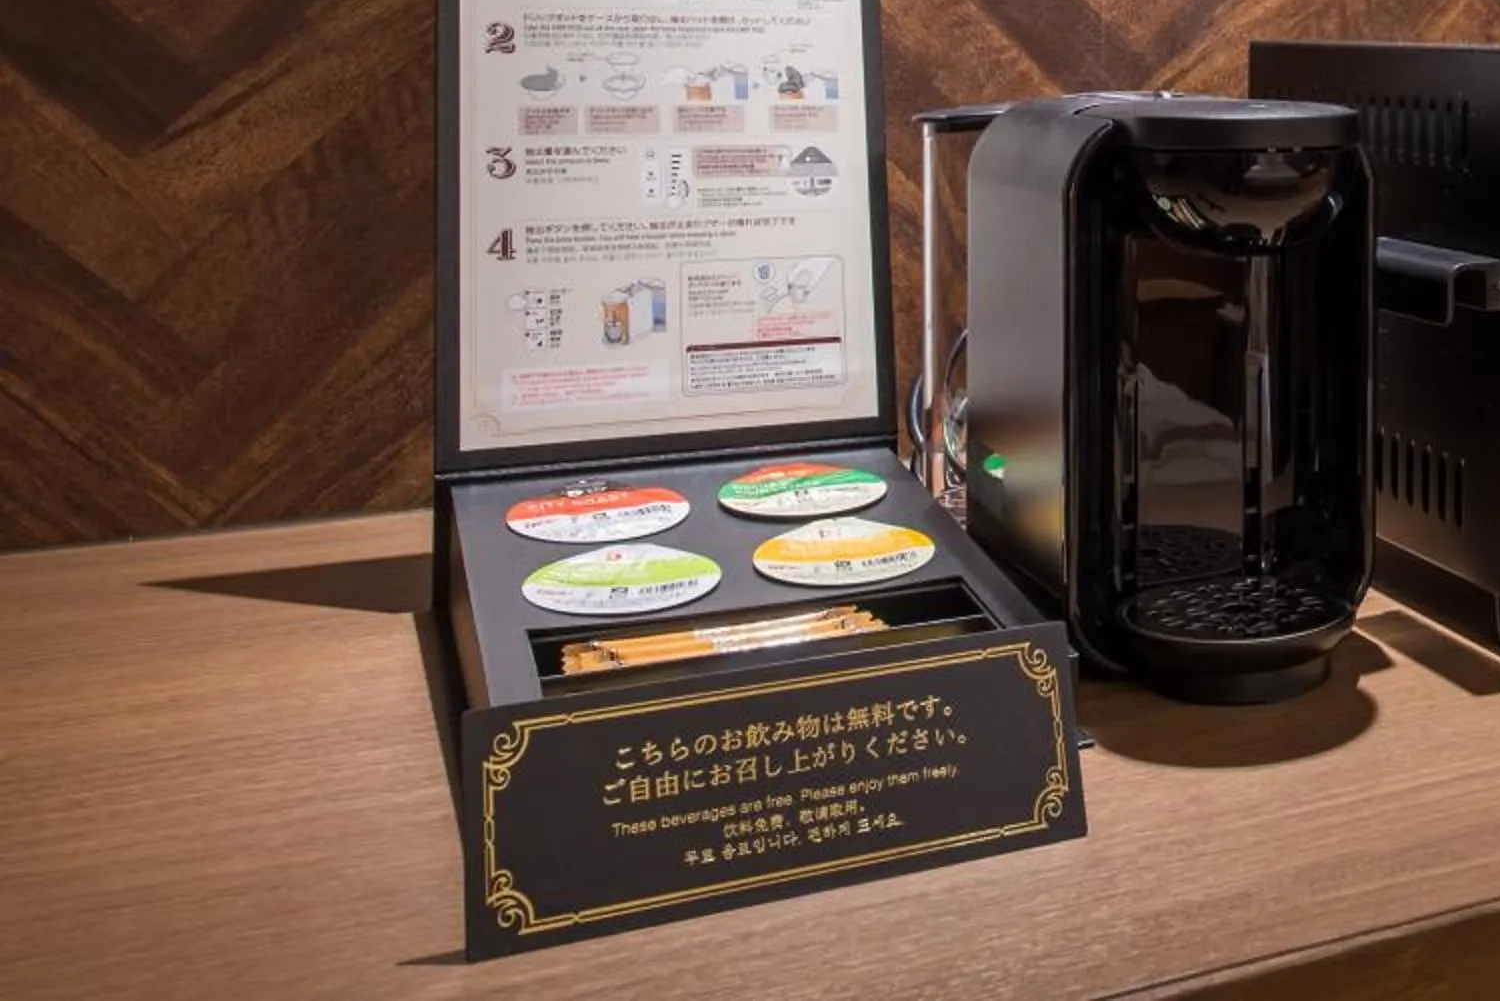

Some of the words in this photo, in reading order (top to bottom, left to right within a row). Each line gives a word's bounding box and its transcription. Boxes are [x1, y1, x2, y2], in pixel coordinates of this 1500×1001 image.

[485, 23, 516, 54] 2
[486, 147, 516, 179] 3
[486, 228, 516, 261] 4
[616, 695, 953, 770] こちらのお飲み物は無料です。
[602, 728, 968, 806] ご自由にお召し上がりください。
[612, 819, 657, 837] These
[661, 805, 736, 828] beverages
[739, 800, 763, 814] are
[801, 784, 845, 803] Please
[849, 778, 884, 795] enjoy
[887, 771, 920, 787] them
